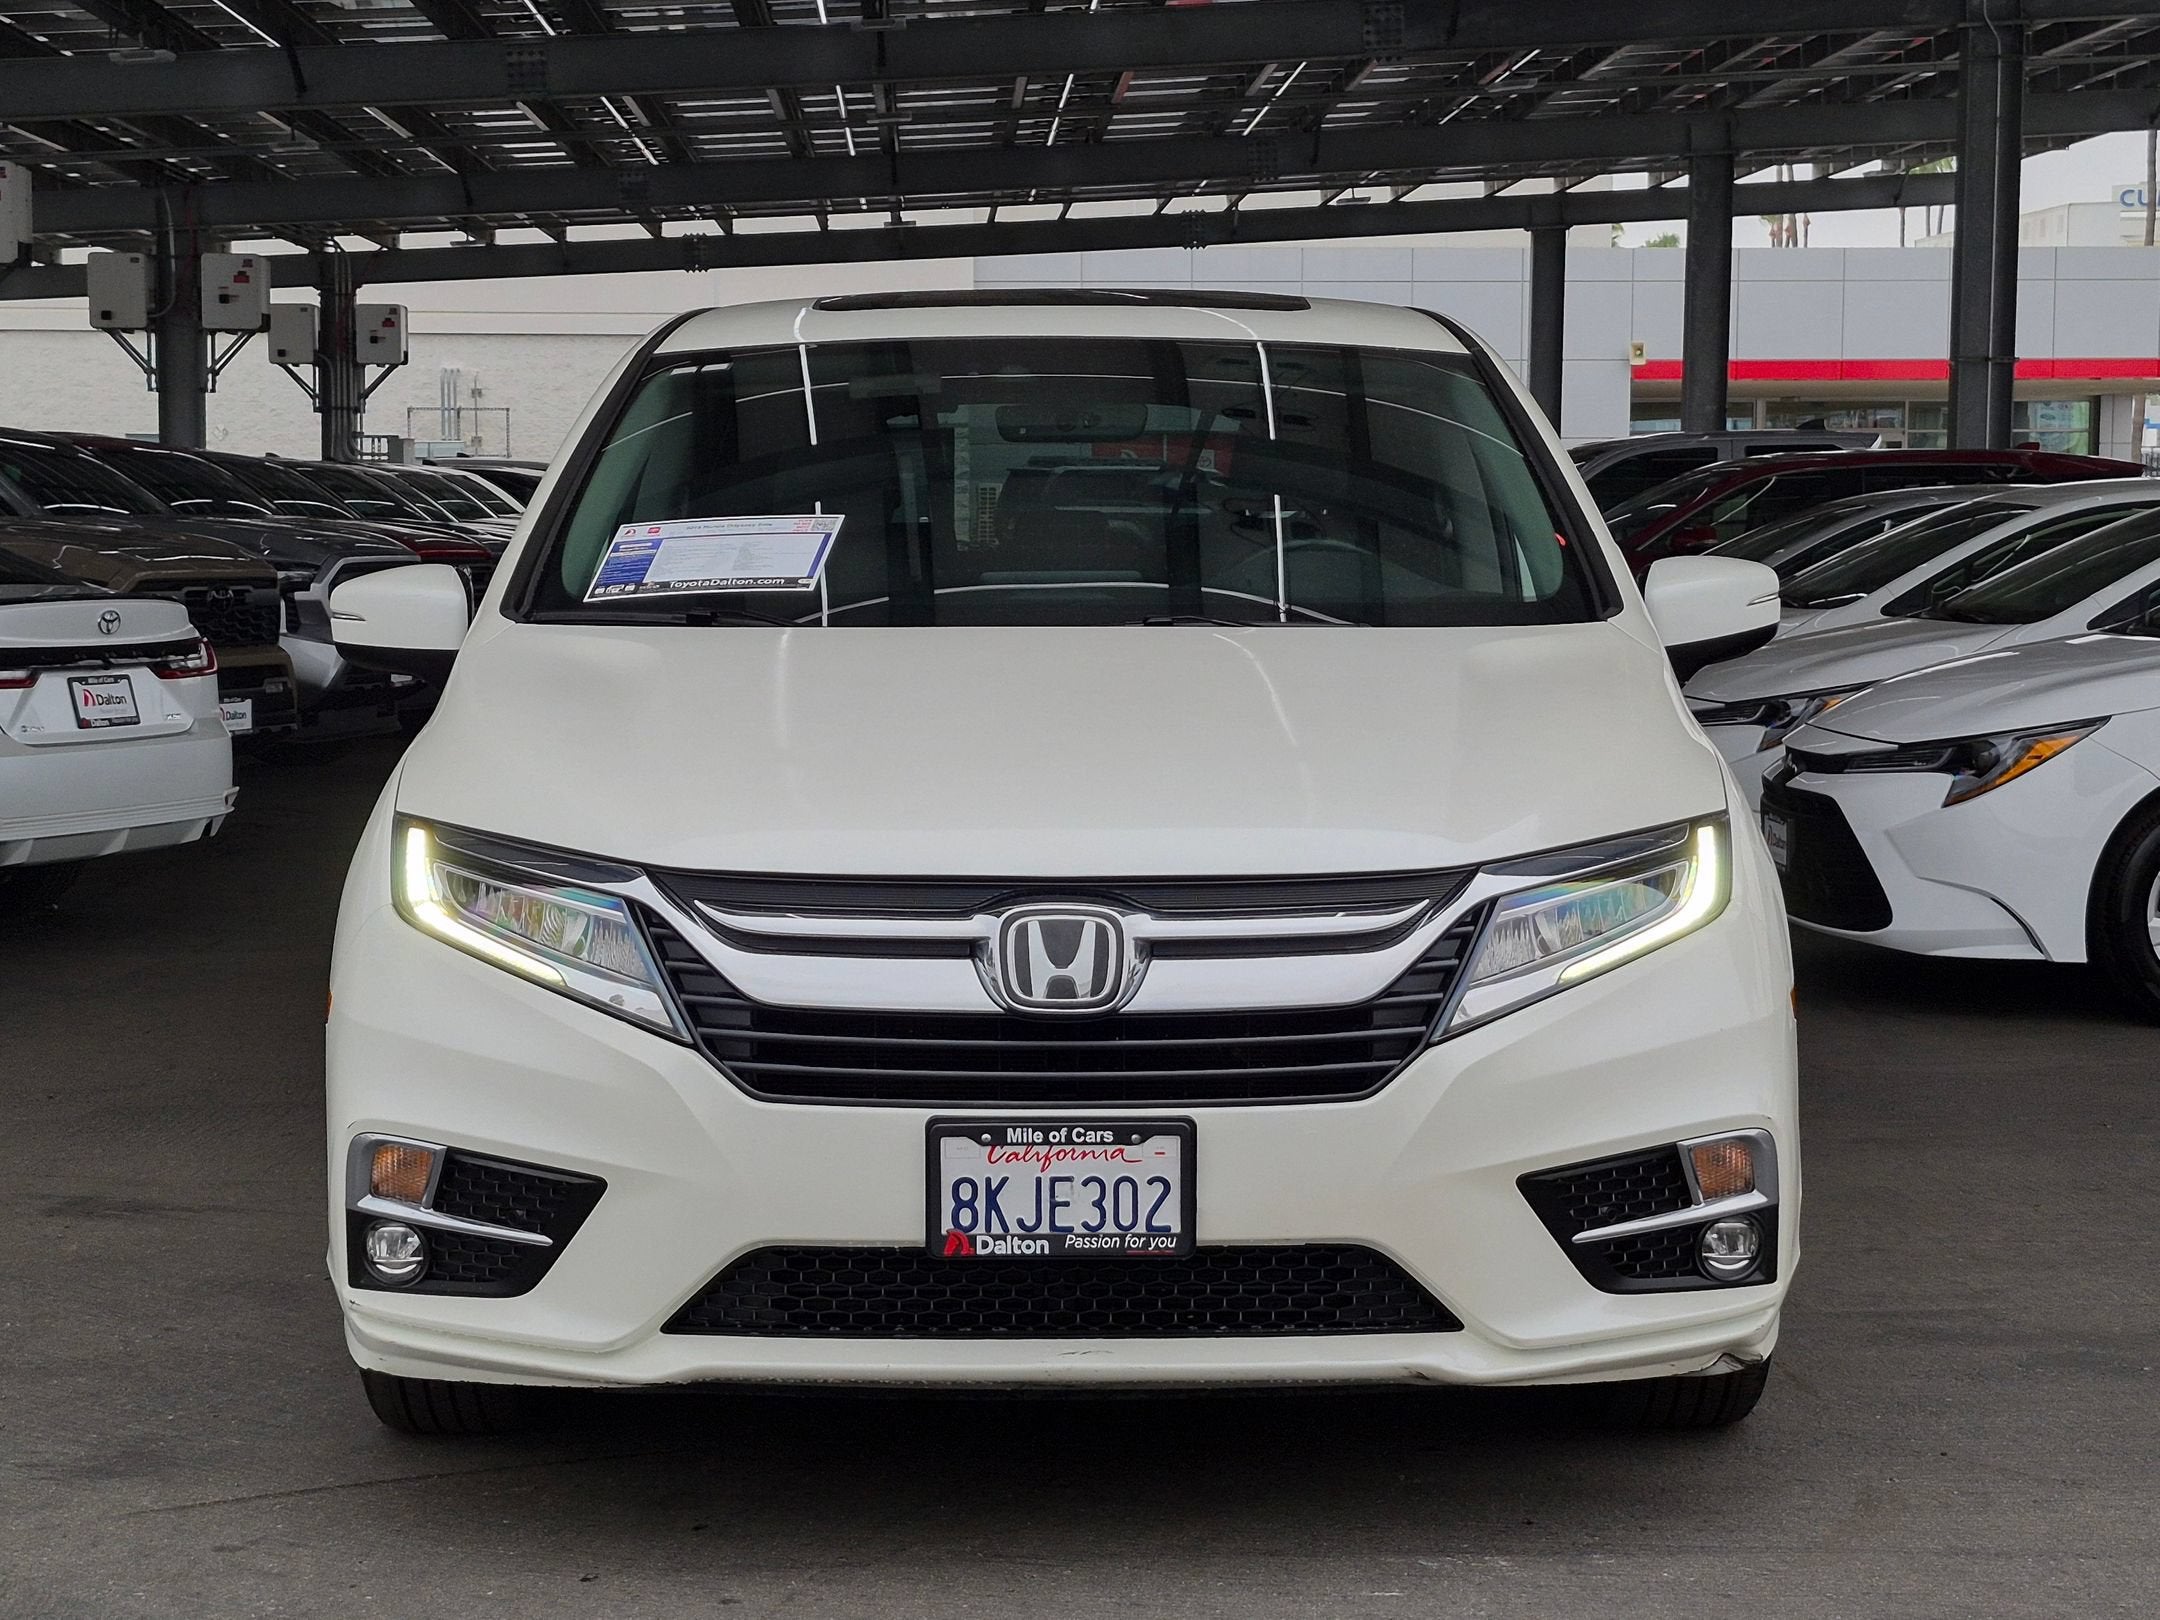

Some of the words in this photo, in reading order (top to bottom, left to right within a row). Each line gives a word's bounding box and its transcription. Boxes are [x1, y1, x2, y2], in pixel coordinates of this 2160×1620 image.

[2120, 189, 2160, 207] CU
[670, 577, 785, 589] ToyotaDalton.com
[96, 693, 128, 706] Dalton
[1006, 1128, 1042, 1143] Mile
[1049, 1128, 1068, 1143] of
[1072, 1128, 1114, 1143] Cars
[987, 1145, 1143, 1173] California
[951, 1175, 1172, 1233] 8KJE302
[976, 1235, 1050, 1255] Dalton
[1065, 1234, 1120, 1249] Passion
[1124, 1234, 1147, 1249] for
[1149, 1236, 1177, 1251] you
